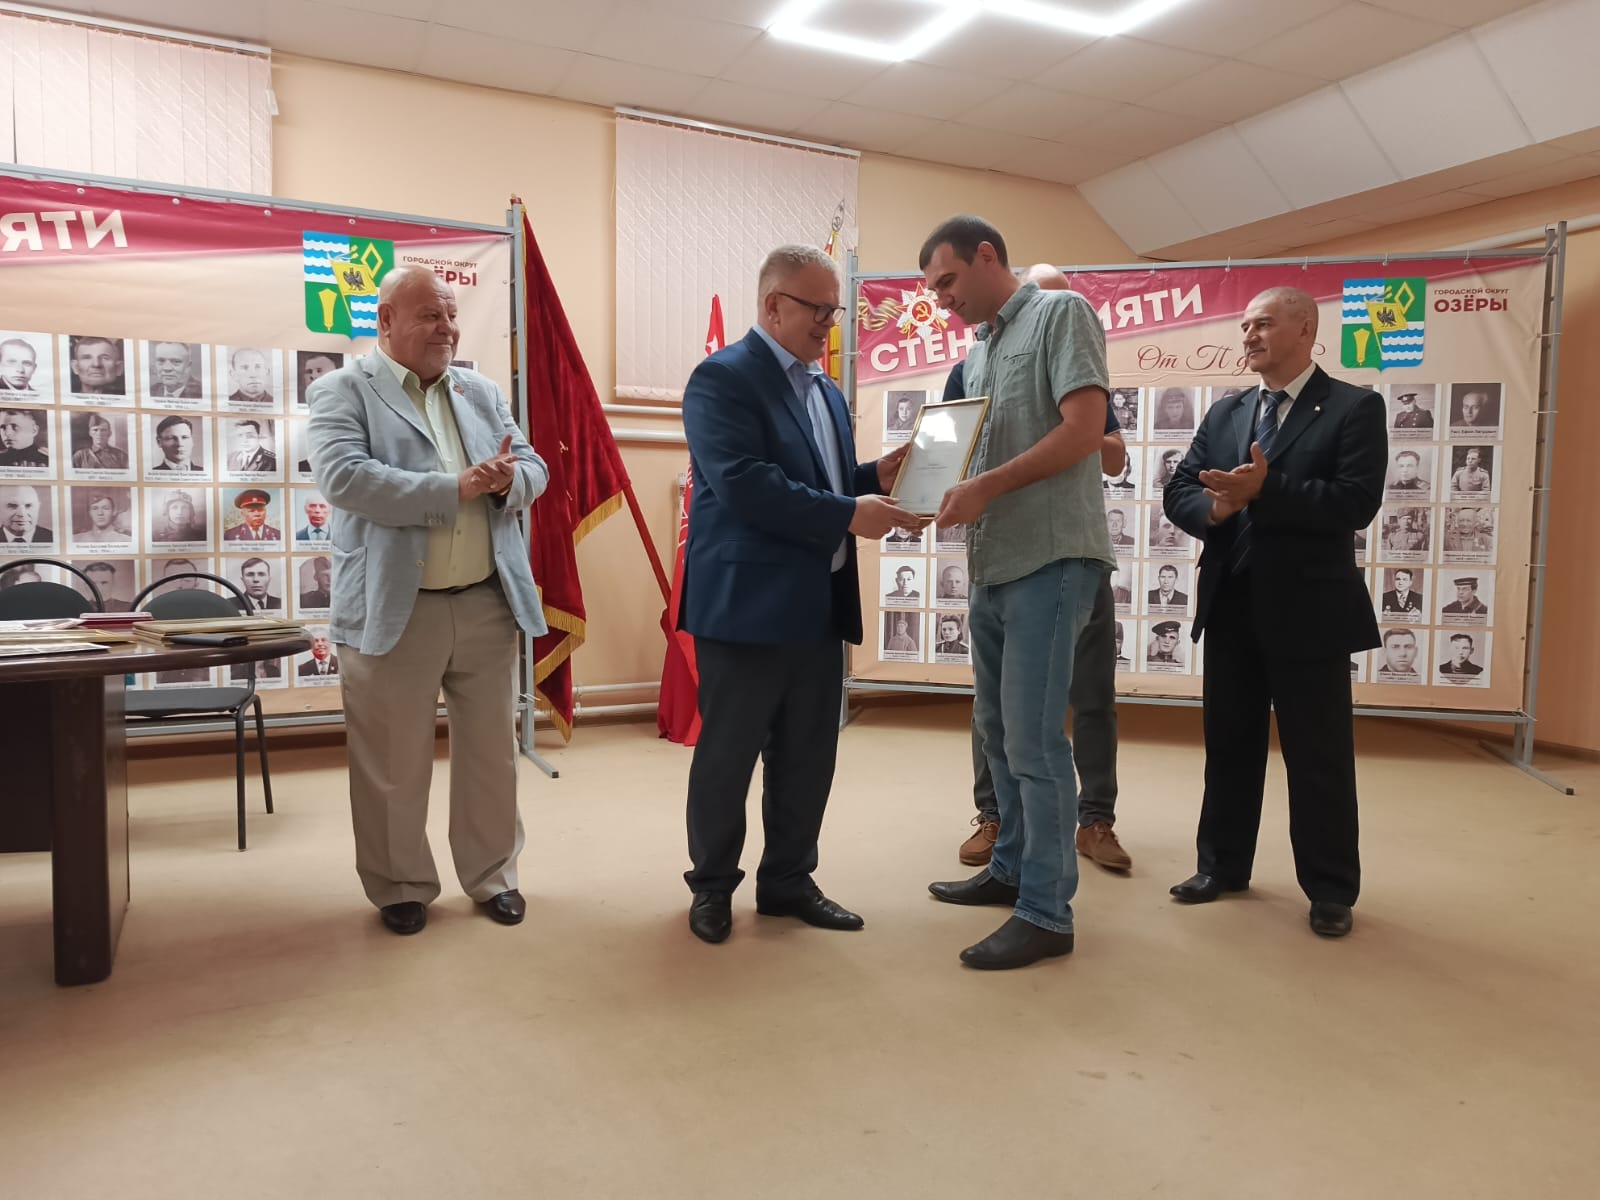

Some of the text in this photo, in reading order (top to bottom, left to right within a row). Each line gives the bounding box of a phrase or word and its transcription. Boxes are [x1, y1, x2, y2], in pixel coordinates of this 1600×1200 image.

[403, 256, 478, 268] ГОРОДСКОЙ ОКРУГ
[434, 266, 477, 287] ЁРЫ
[1434, 295, 1507, 312] ОЗЁРЫ
[870, 327, 975, 372] СТЕН
